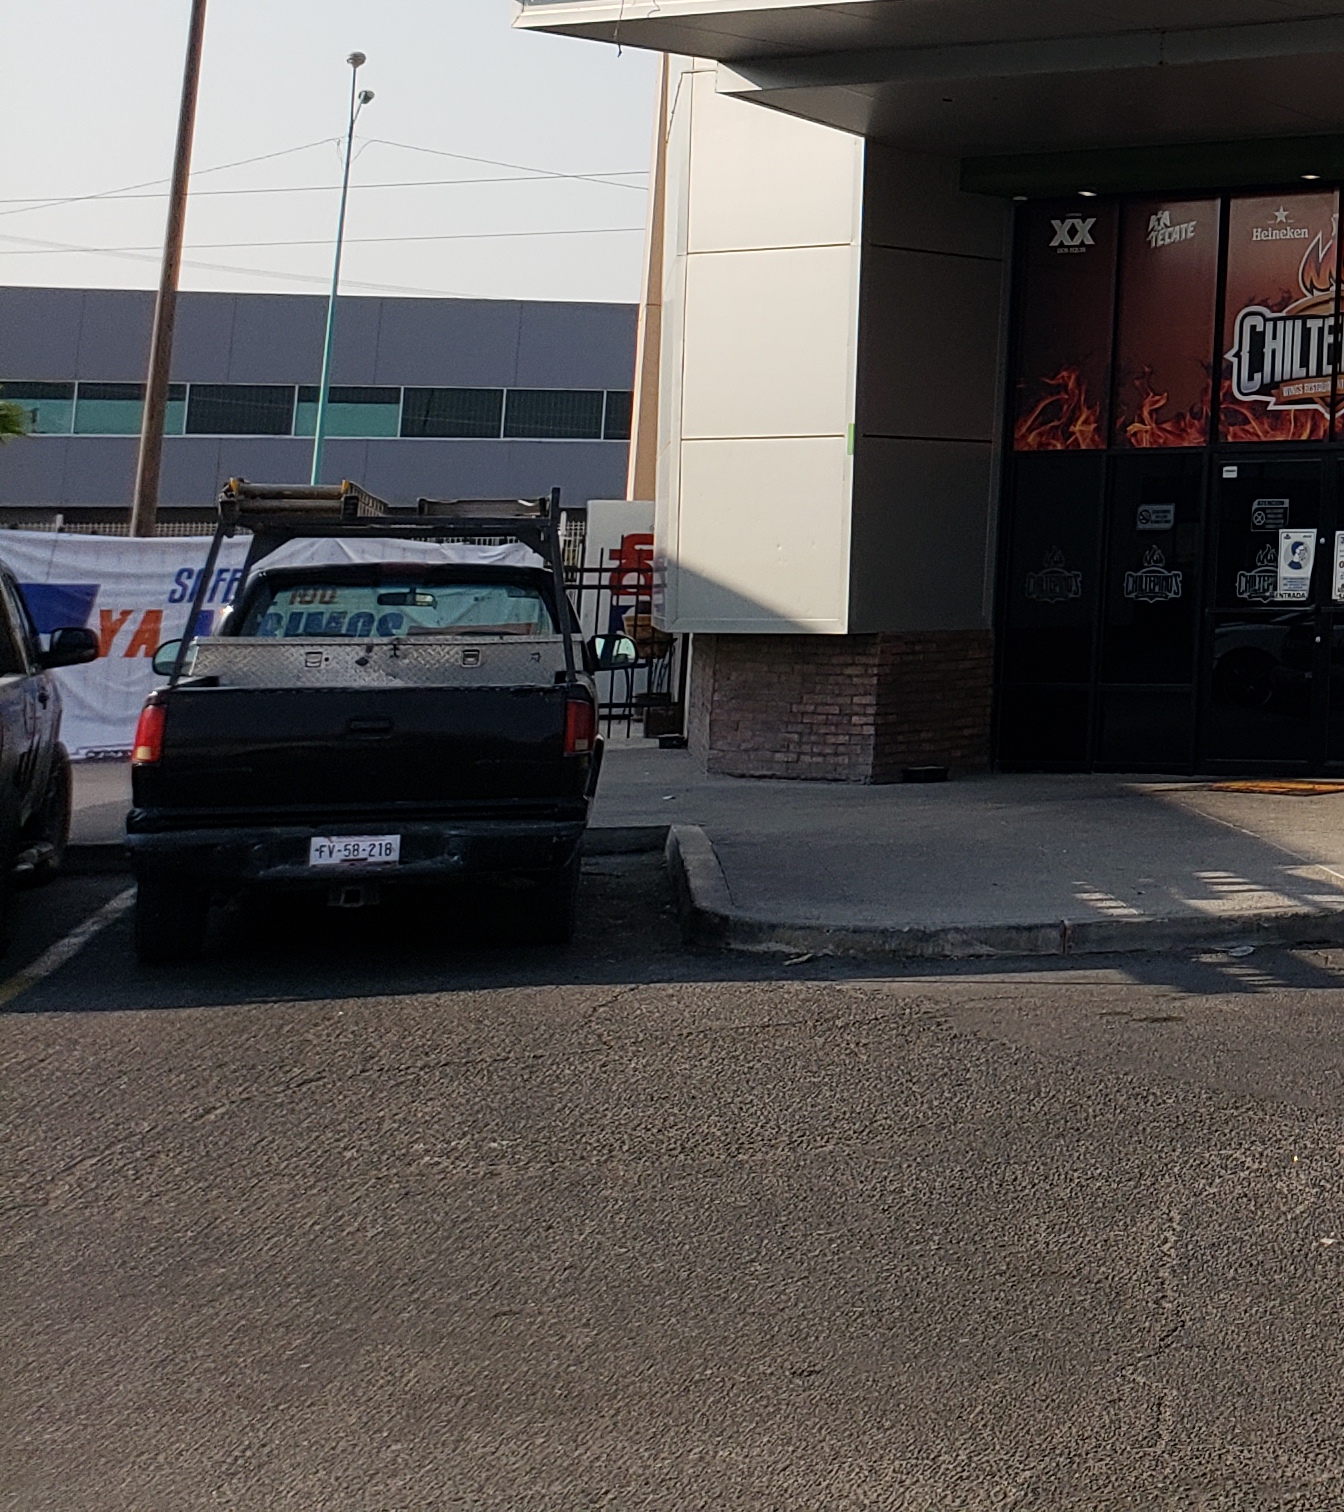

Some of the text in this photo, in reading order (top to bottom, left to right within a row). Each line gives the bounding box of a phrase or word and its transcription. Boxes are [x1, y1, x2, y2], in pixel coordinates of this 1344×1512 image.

[1049, 217, 1097, 247] XX
[1146, 220, 1198, 249] TECATE
[1252, 226, 1309, 241] Heineken
[98, 609, 164, 658] YA
